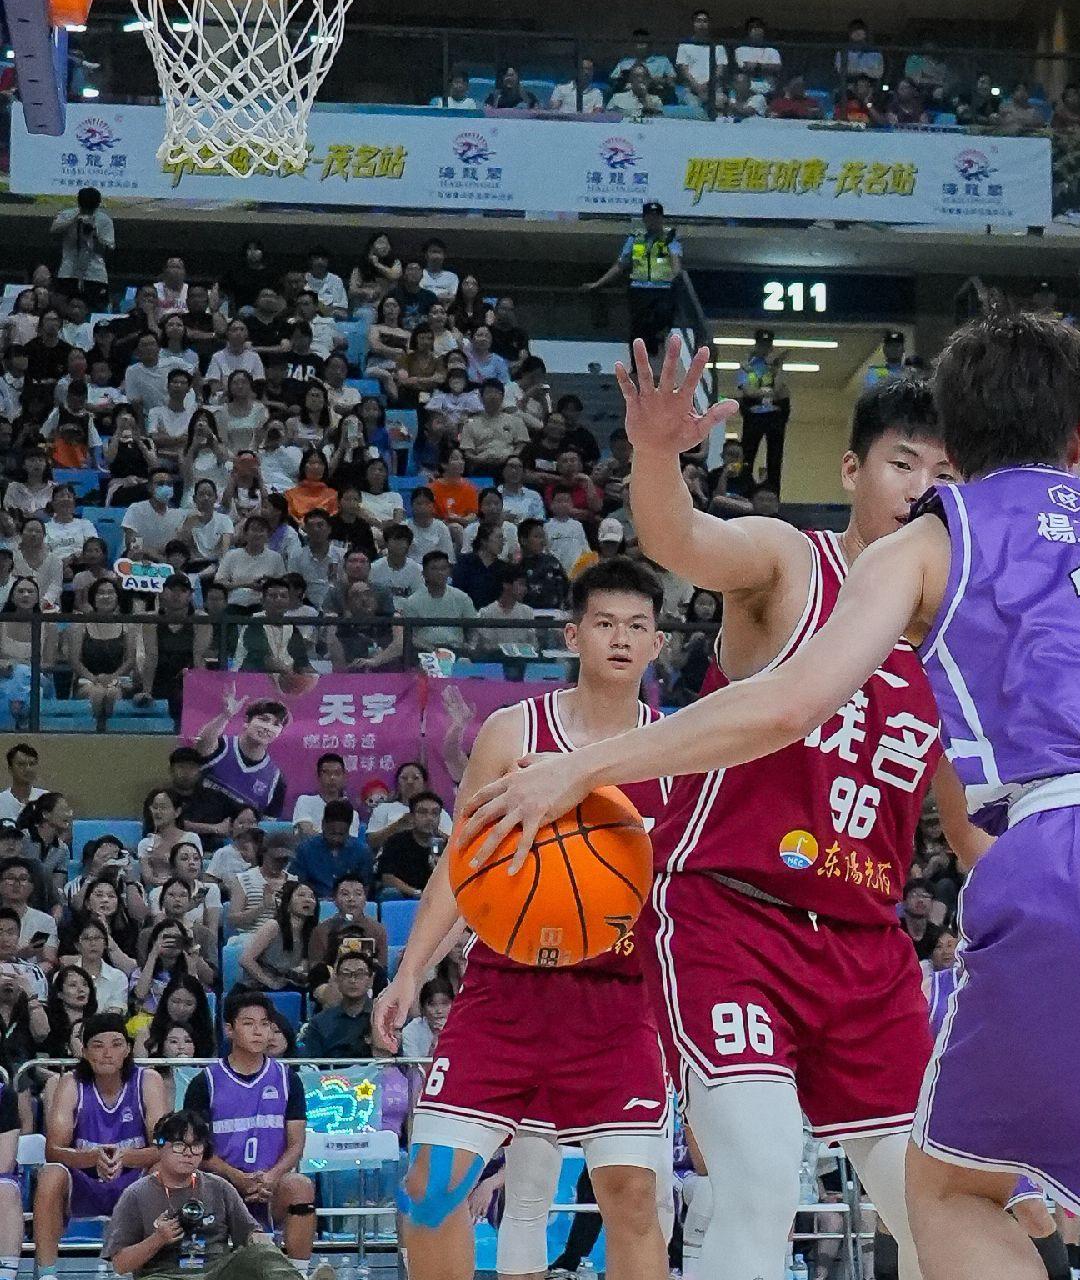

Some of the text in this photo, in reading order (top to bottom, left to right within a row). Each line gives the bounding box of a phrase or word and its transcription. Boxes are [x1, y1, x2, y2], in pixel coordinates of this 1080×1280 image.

[763, 282, 827, 312] 211
[124, 576, 160, 590] Ask
[318, 692, 398, 727] 天宇
[804, 689, 939, 794] 茂名
[829, 775, 881, 840] 96
[711, 1001, 775, 1056] 96
[425, 1057, 450, 1096] 6
[244, 1137, 258, 1164] 0
